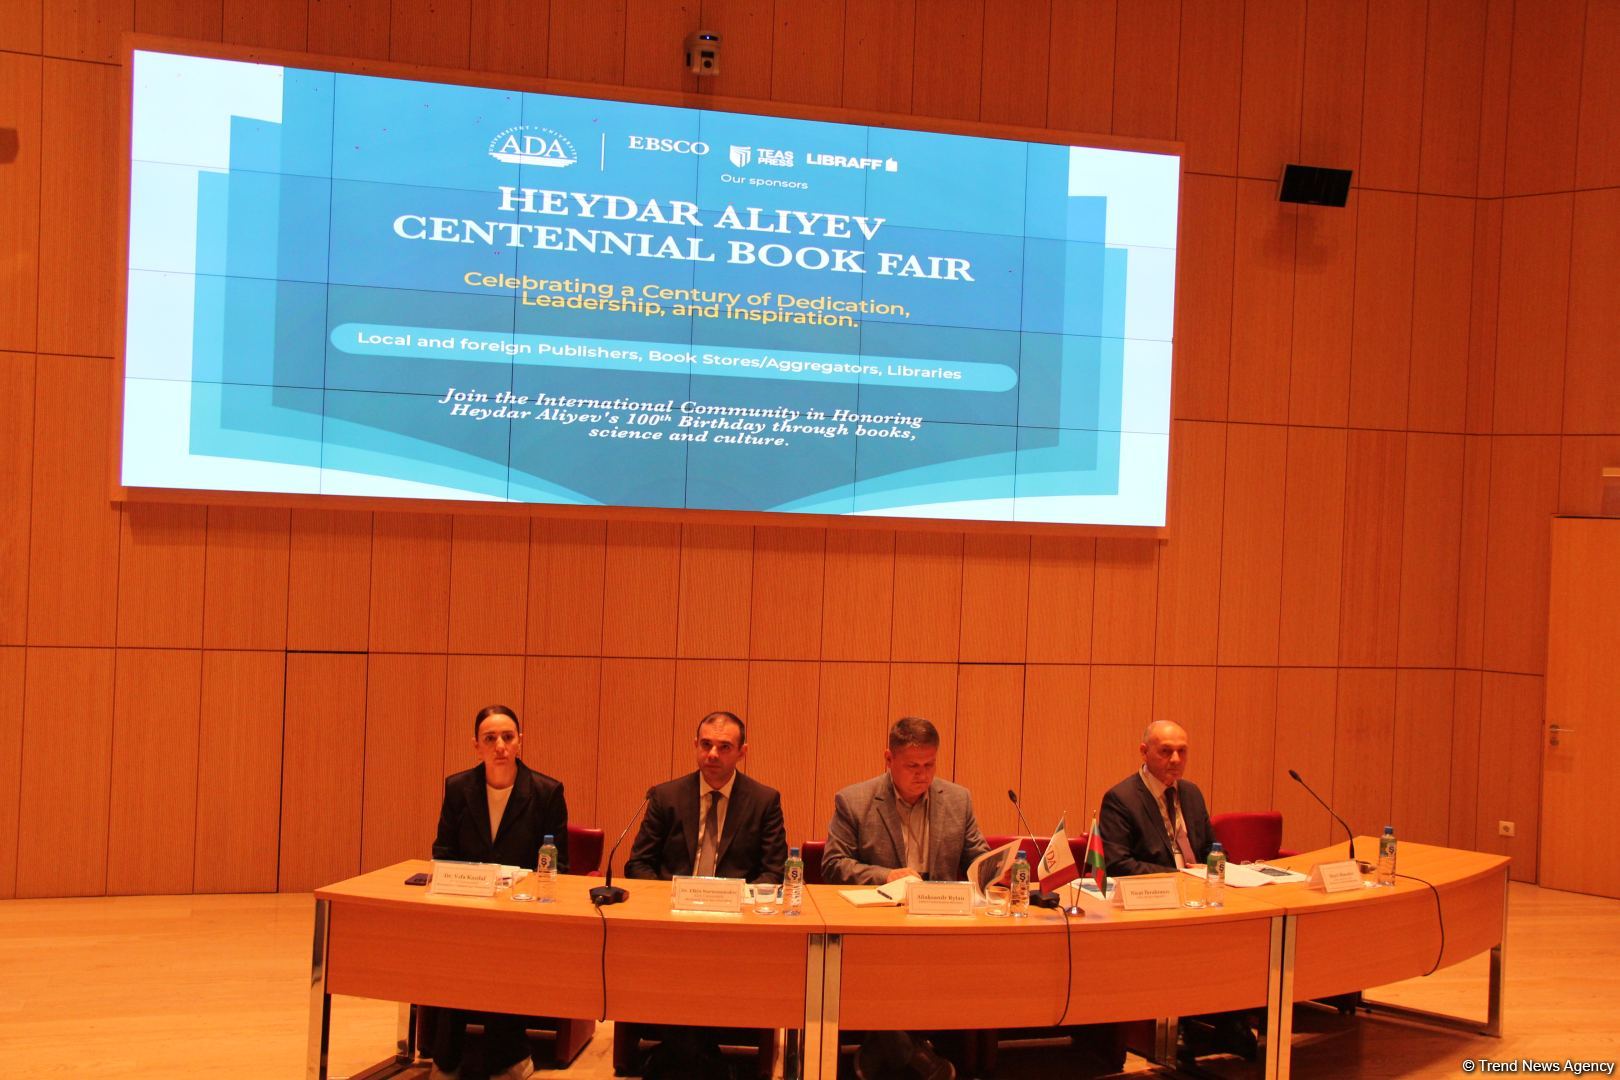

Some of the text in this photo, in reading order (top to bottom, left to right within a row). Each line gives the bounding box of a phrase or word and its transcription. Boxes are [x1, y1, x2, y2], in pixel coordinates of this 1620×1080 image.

[499, 134, 568, 159] ADA
[628, 135, 710, 155] EBSCO
[757, 148, 794, 160] TEAS
[758, 157, 794, 168] PRESS
[806, 153, 882, 170] LIBRAFF
[721, 174, 809, 190] Our sponsors
[497, 186, 887, 241] HEYDAR ALIYEV
[393, 215, 975, 282] CENTENNIAL BOOK FAIR
[464, 272, 911, 318] Celebrating a Century of Dedication,
[522, 290, 859, 328] Leadership, and Inspiration.
[358, 332, 962, 380] Local and foreign Publishers, Book Stores/Aggregators, Libraries
[438, 388, 923, 428] Join the International Community in Honoring
[450, 403, 917, 441] Heydar Aliyev's 100th Birthday through books,
[588, 426, 790, 447] science and culture.
